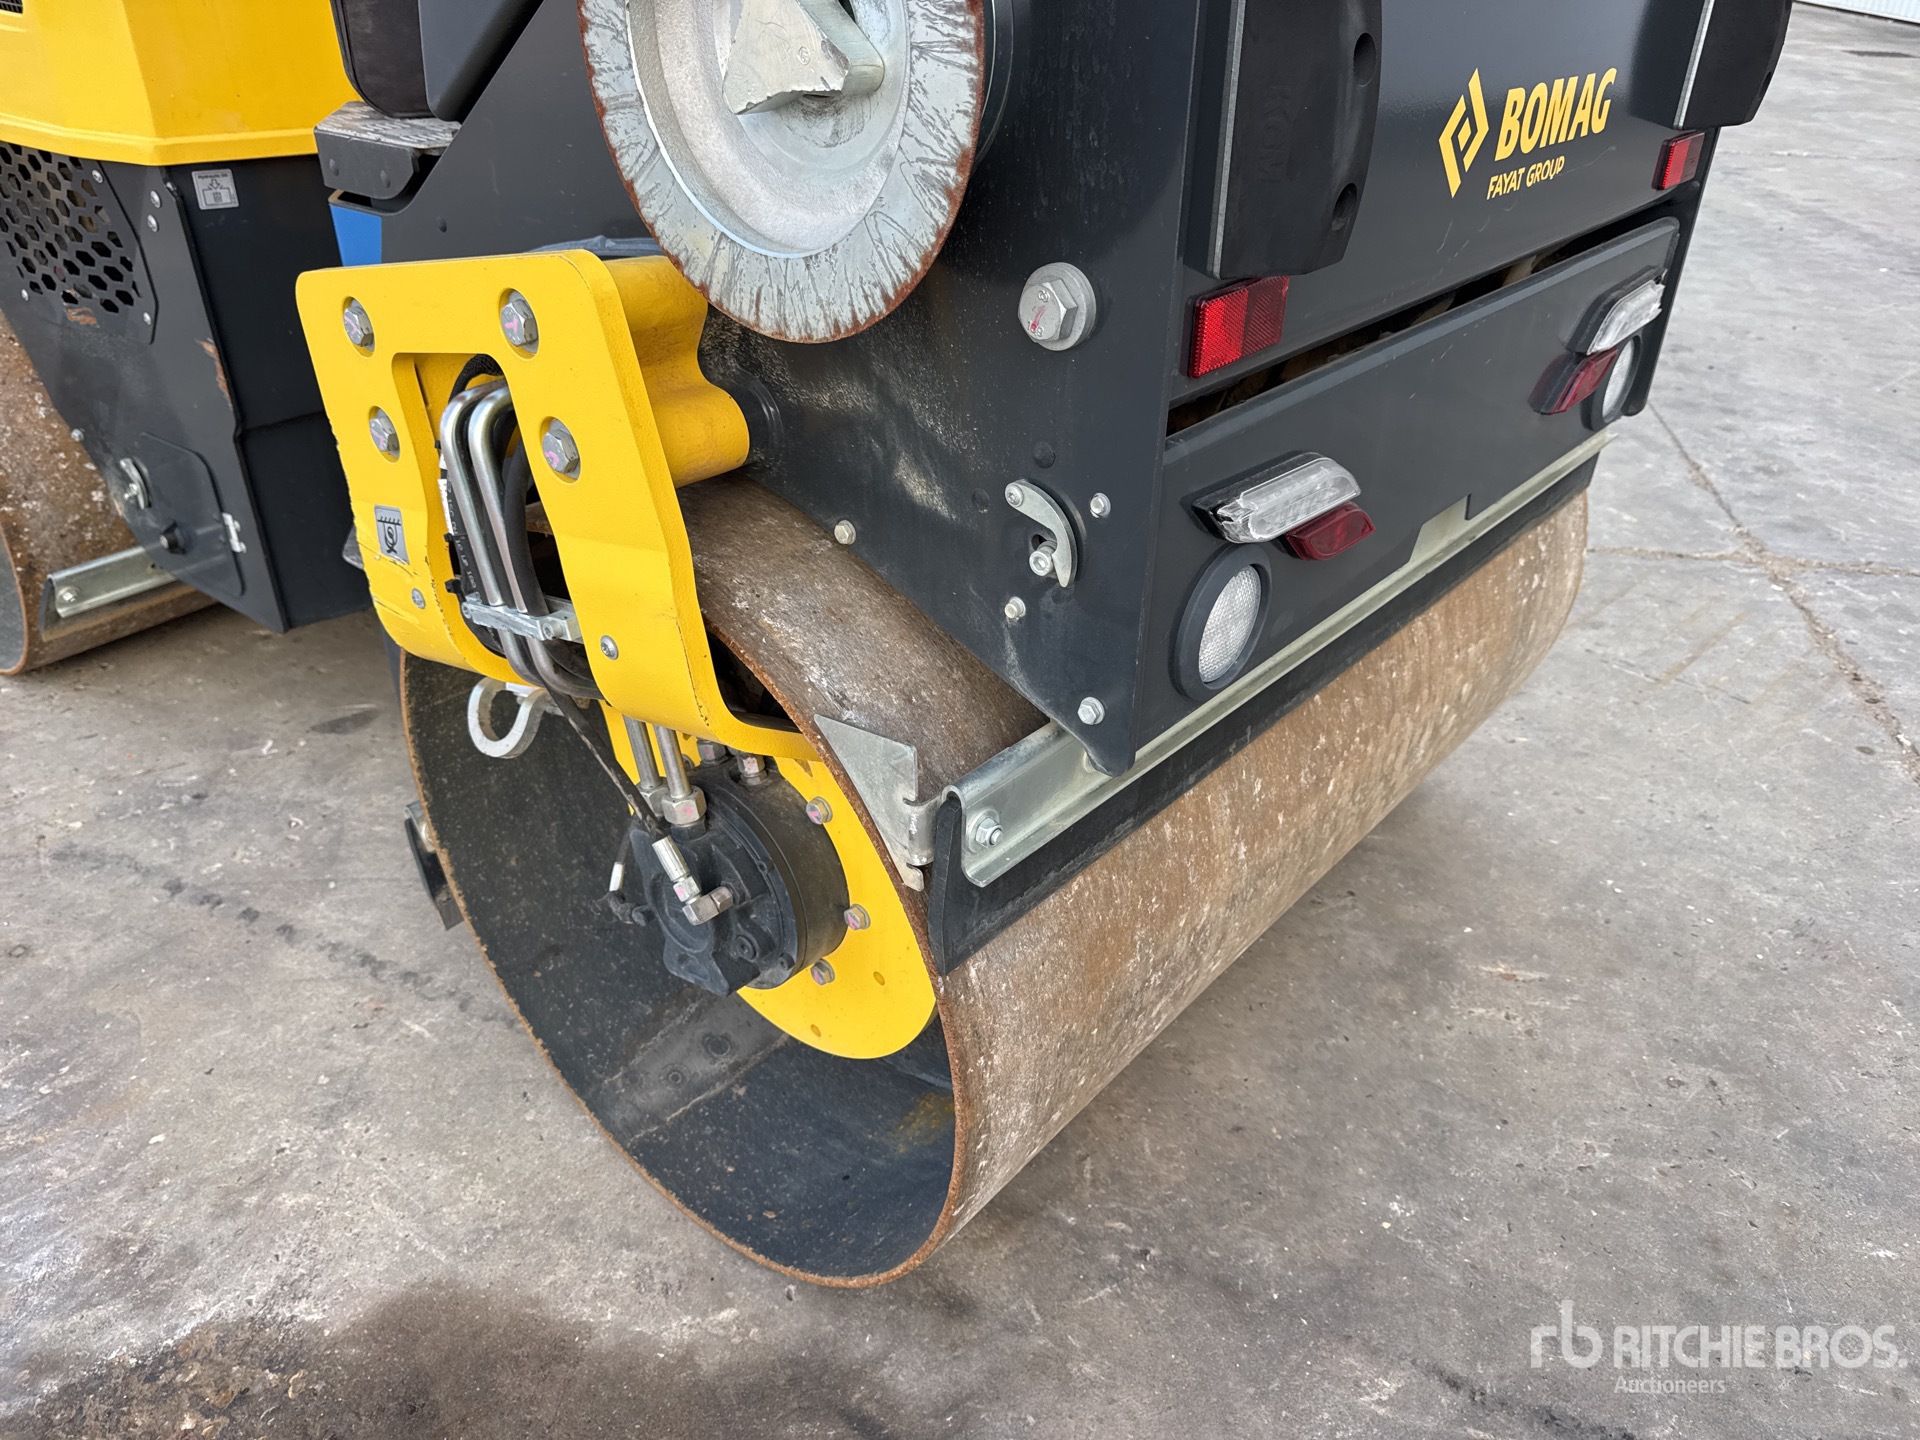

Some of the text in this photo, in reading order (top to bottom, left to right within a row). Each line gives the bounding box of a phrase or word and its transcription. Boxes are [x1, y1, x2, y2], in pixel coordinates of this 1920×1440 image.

[1494, 67, 1618, 162] BOMAG
[1486, 155, 1566, 201] FAYAT GROUP
